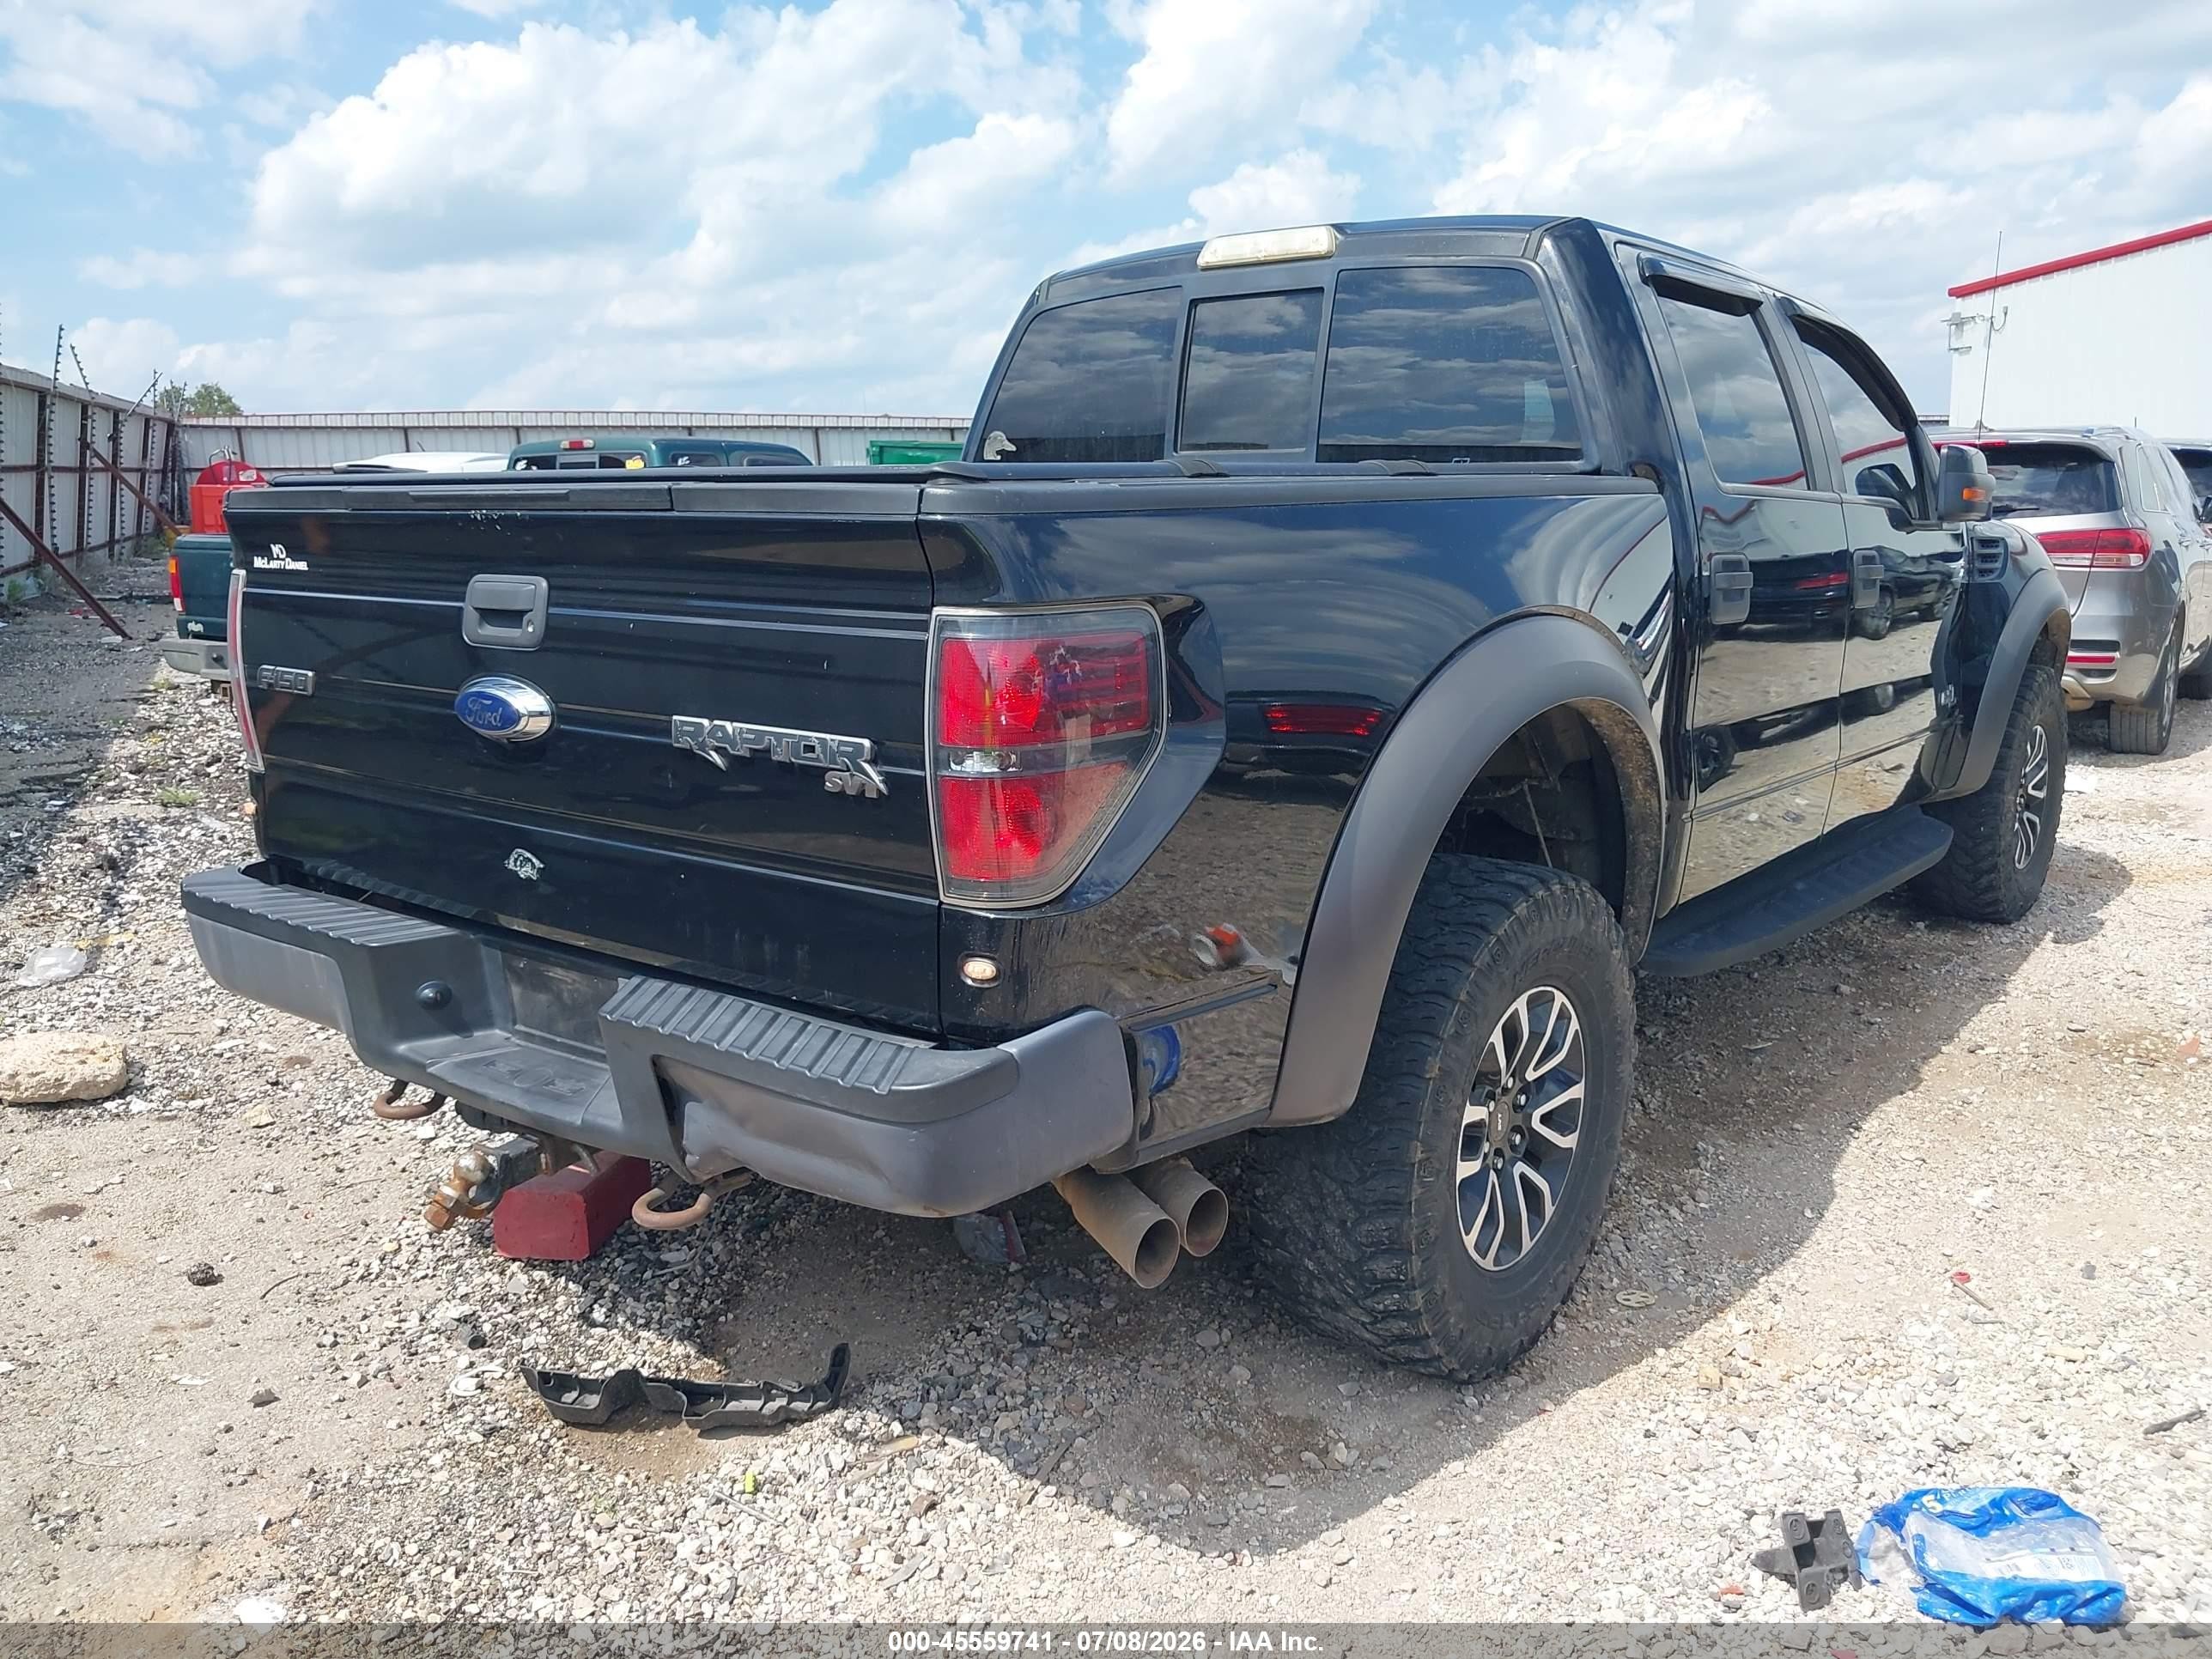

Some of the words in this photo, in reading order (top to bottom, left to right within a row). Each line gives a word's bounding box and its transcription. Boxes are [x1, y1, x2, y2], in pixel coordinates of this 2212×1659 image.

[465, 696, 503, 726] Ford
[672, 715, 889, 796] RAPTOR
[824, 770, 879, 798] SVT
